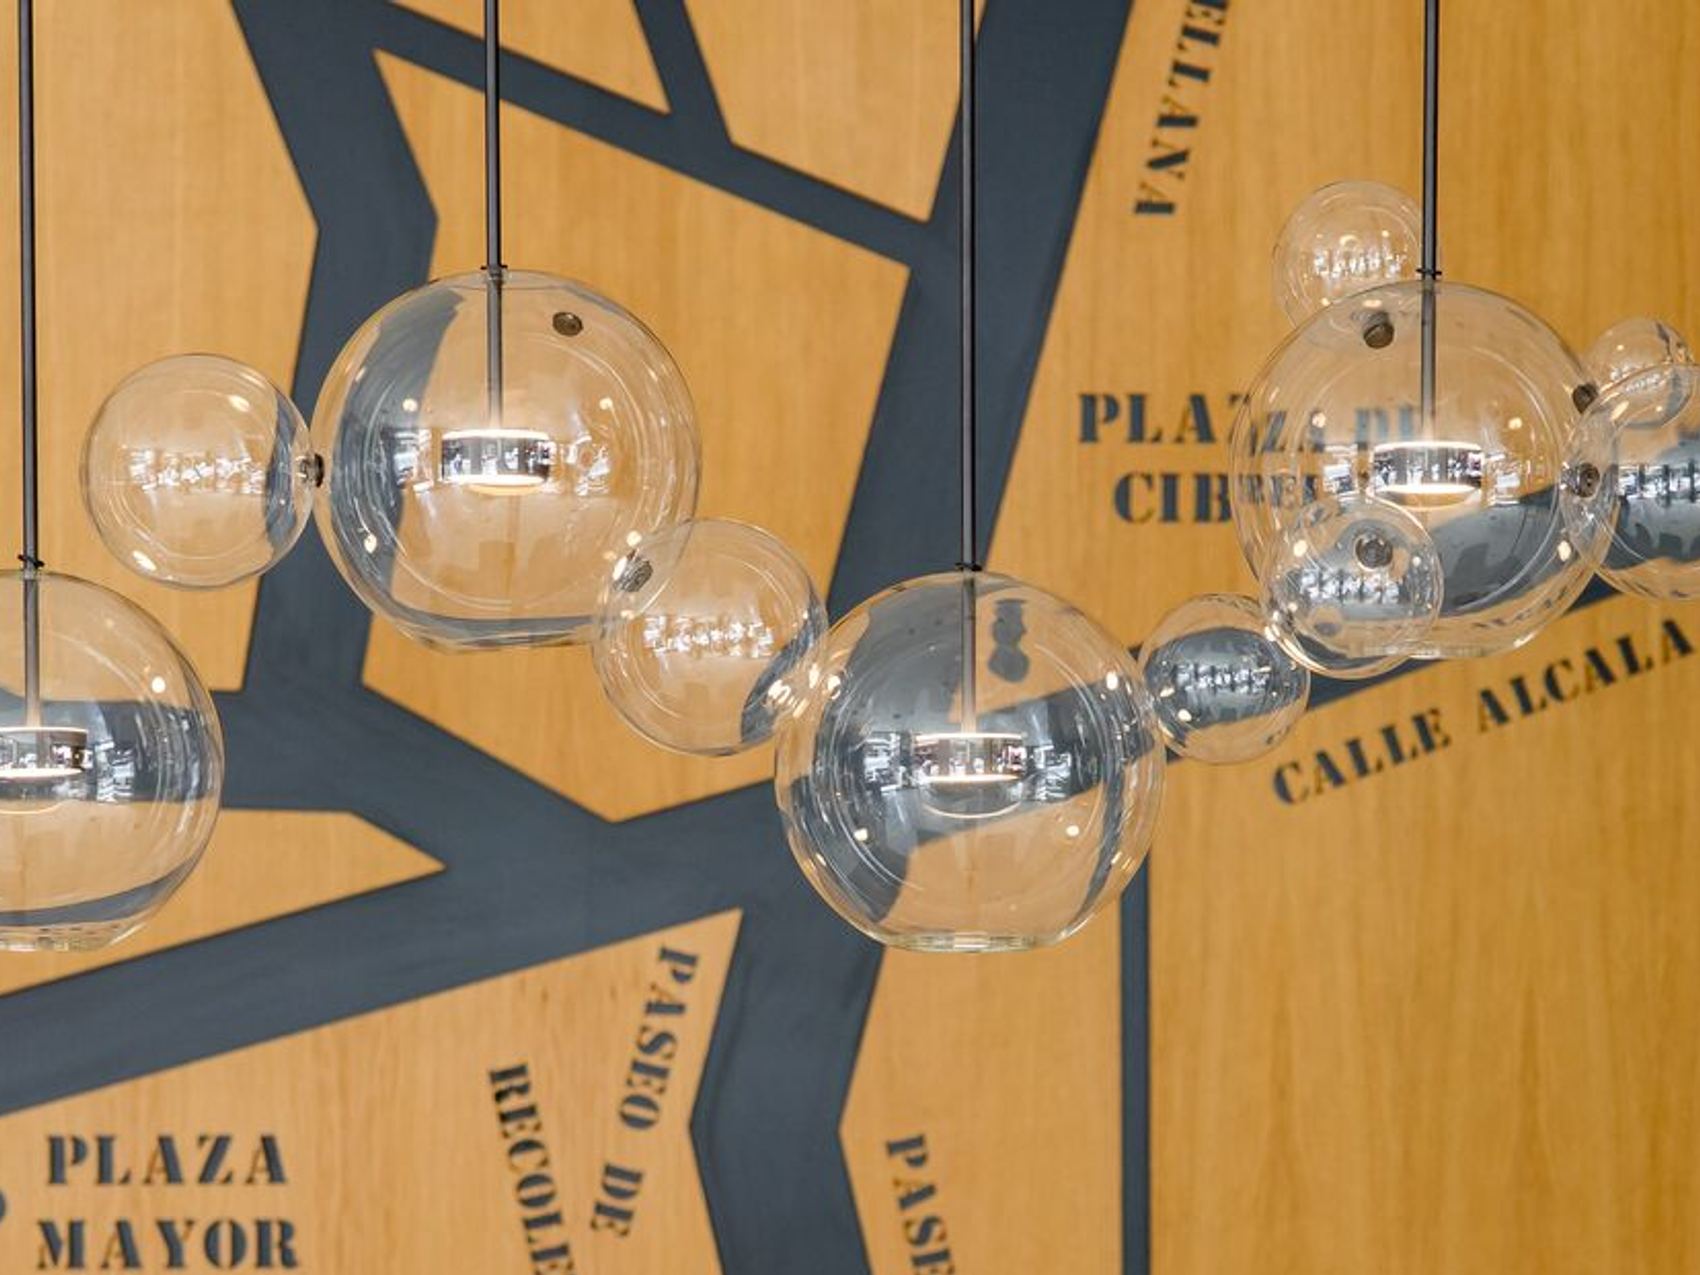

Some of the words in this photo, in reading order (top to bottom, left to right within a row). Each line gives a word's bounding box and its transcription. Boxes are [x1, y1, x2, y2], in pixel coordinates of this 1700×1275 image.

[1273, 709, 1451, 804] CALLE
[1477, 618, 1694, 733] ALCALA
[618, 945, 698, 1132] PASEO
[47, 1135, 287, 1186] PLAZA
[590, 1161, 643, 1238] DE
[37, 1219, 299, 1270] MAYOR
